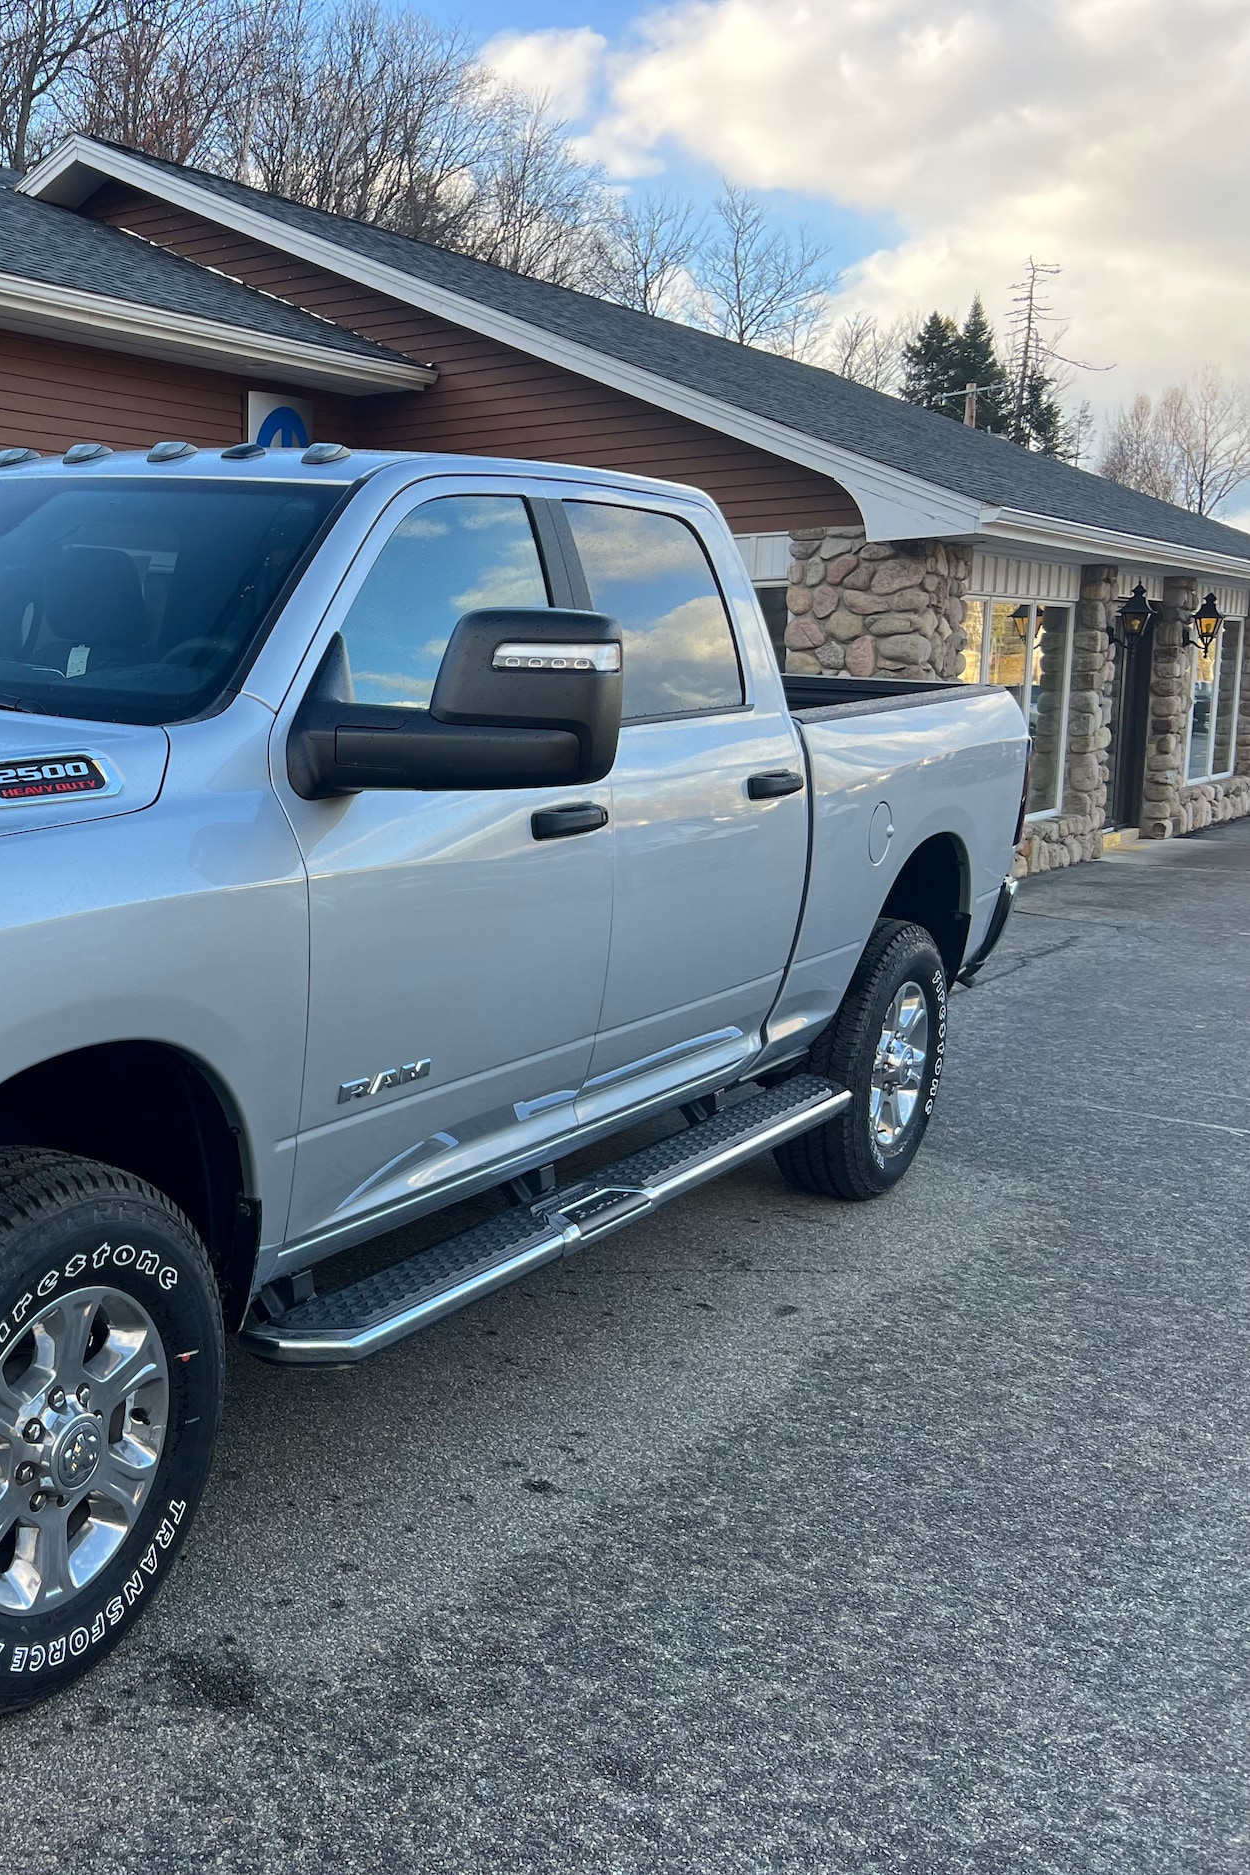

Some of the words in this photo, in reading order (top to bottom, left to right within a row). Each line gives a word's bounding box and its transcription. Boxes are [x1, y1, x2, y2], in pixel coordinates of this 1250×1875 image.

[1, 784, 53, 798] HEAVY
[55, 780, 97, 792] DUTY
[337, 1057, 432, 1105] RAM
[10, 1500, 186, 1672] TRANSFORCE
